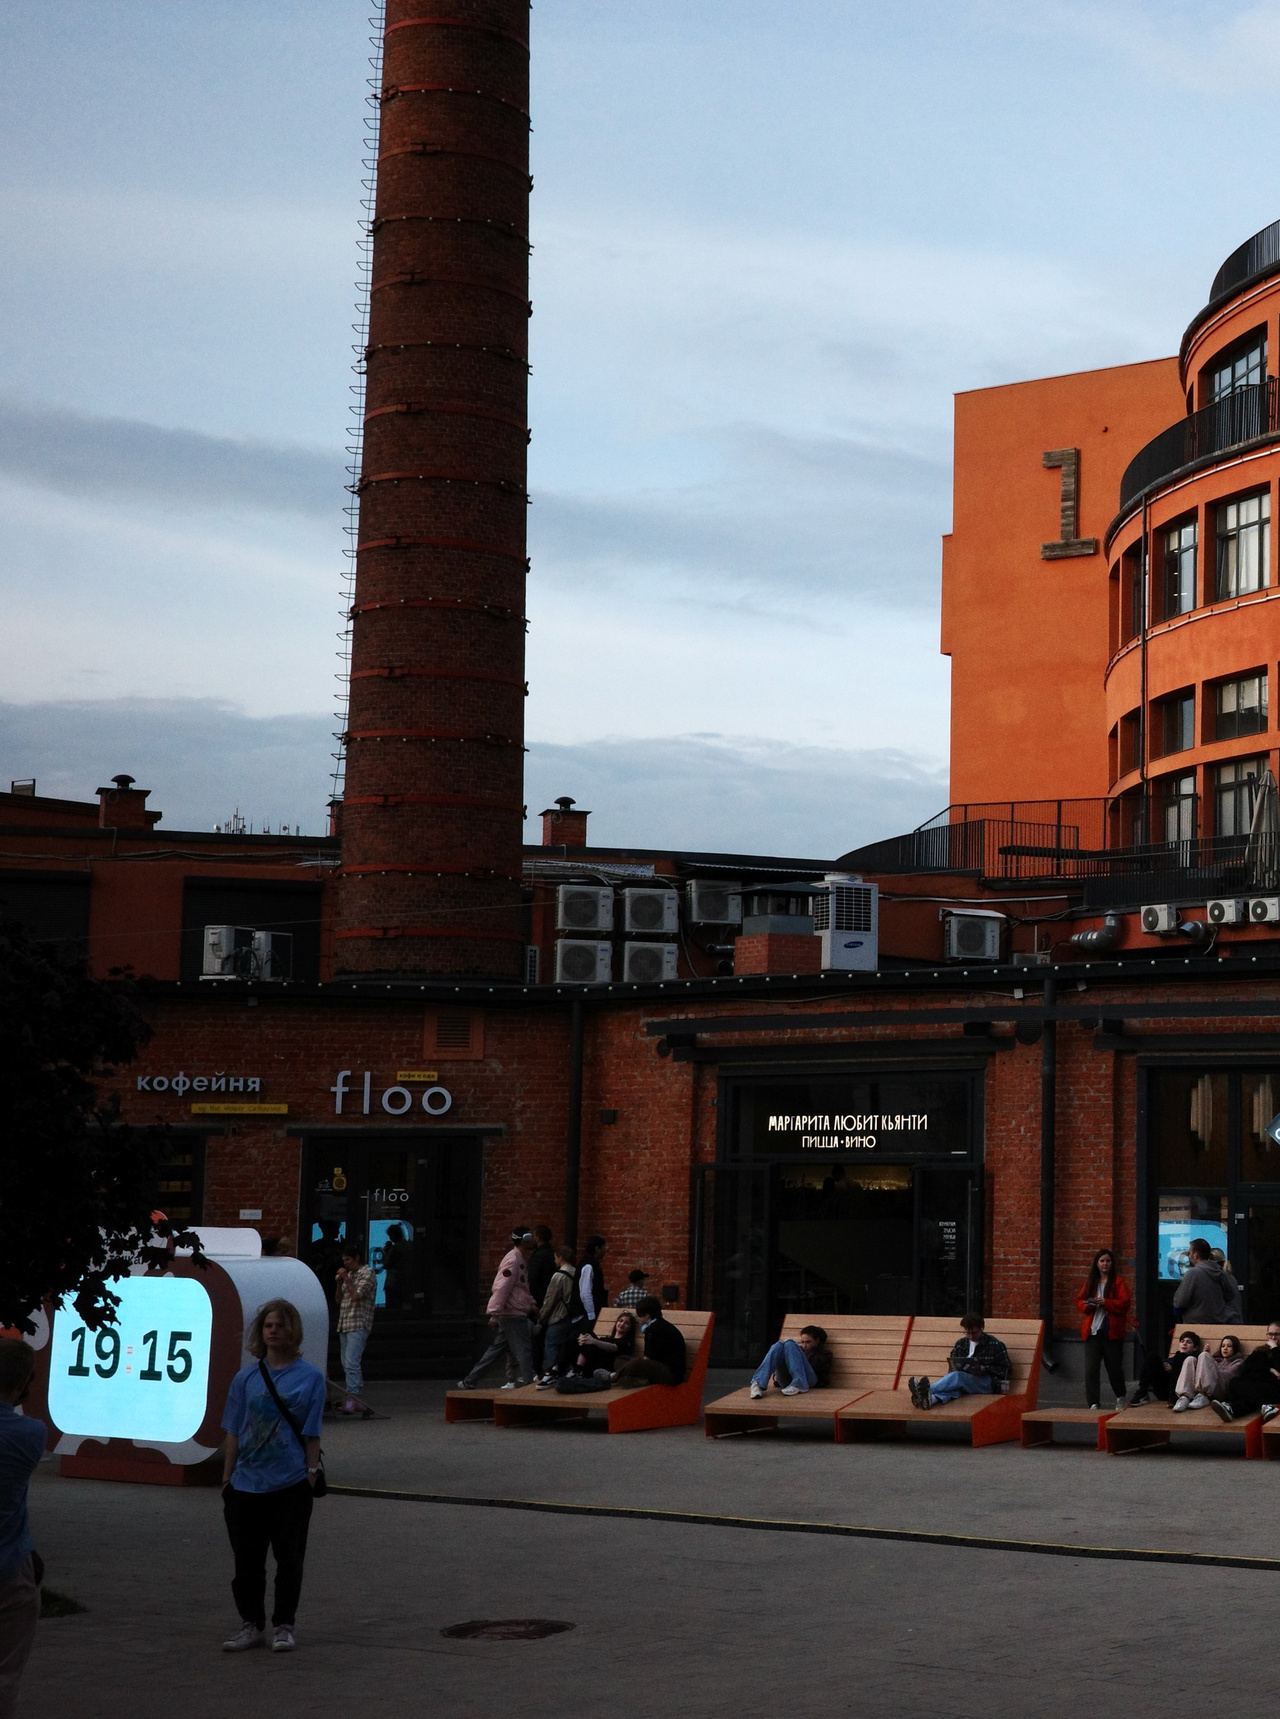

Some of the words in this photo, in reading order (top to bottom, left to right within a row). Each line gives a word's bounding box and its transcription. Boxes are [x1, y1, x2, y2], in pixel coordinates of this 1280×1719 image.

[1041, 447, 1095, 560] 1
[136, 1071, 260, 1097] кофейня
[768, 1115, 831, 1131] МАРГАРИТА
[834, 1115, 880, 1131] ЛЮБИТ
[881, 1114, 928, 1131] КЬЯНТИ
[802, 1135, 839, 1148] ПИЦЦА
[845, 1135, 877, 1148] ВИНО
